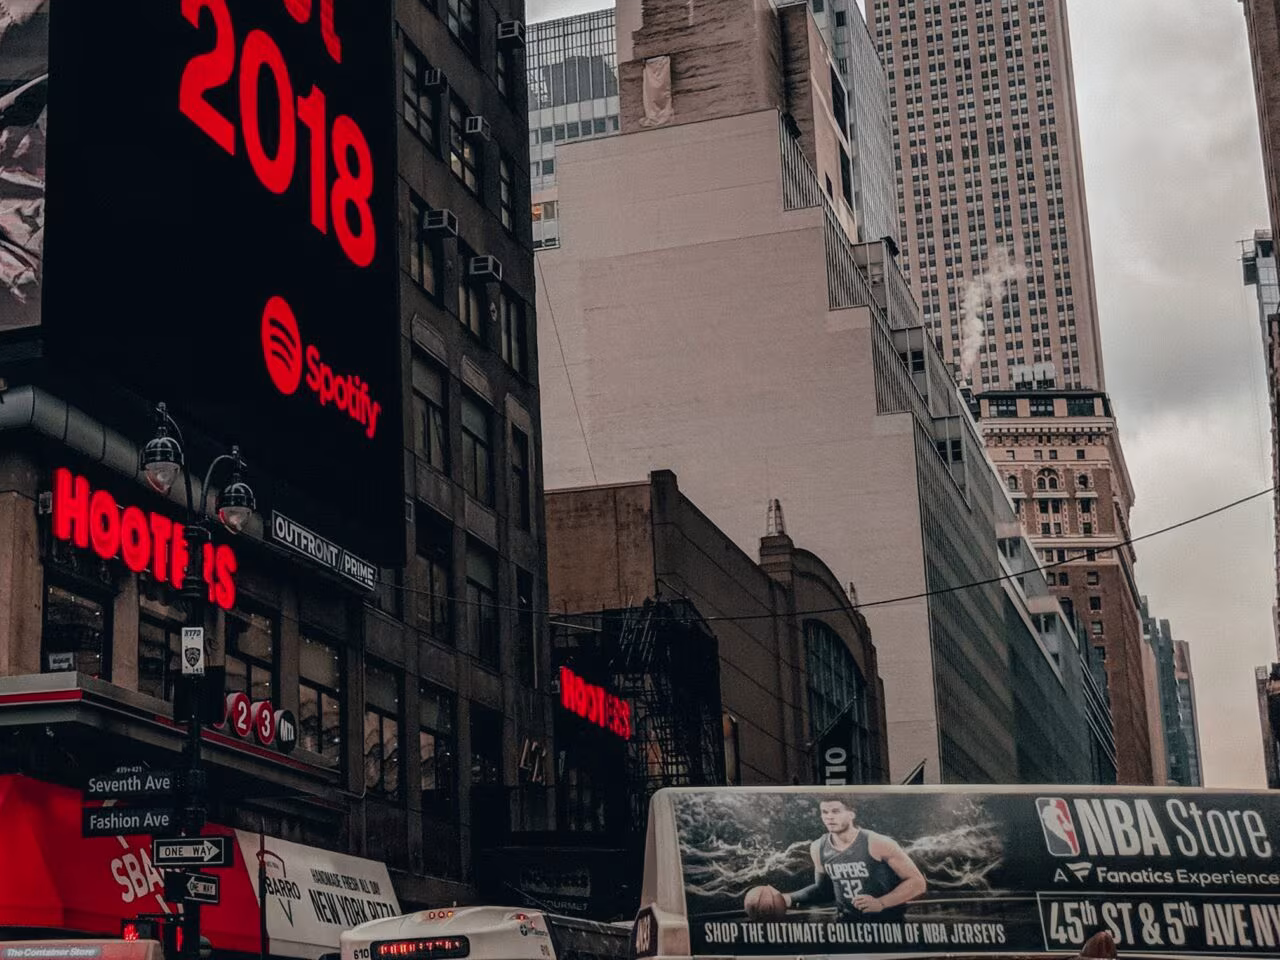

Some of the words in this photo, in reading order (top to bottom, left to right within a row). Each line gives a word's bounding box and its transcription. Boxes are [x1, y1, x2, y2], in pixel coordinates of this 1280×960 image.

[306, 343, 380, 440] Spotify
[275, 516, 338, 567] OUTFRONT
[344, 554, 374, 587] PRIME
[237, 700, 248, 730] 2
[261, 709, 271, 737] 3
[88, 775, 141, 793] Seventh
[144, 774, 171, 790] Ave
[90, 812, 140, 830] Fashion
[143, 812, 170, 827] Ave
[1072, 798, 1172, 856] NBA
[1166, 798, 1273, 858] Store
[164, 846, 184, 857] ONE
[192, 845, 213, 856] WAY
[310, 868, 342, 889] HANDMADE
[341, 874, 360, 892] FRESH
[358, 878, 371, 895] ALL
[369, 880, 382, 896] DAY
[1053, 868, 1069, 882] A
[1096, 866, 1174, 884] Fanatics
[1176, 868, 1280, 887] Experience
[840, 879, 863, 899] 32
[308, 888, 342, 926] NEW
[336, 894, 368, 927] YORK
[704, 922, 739, 944] SHOP
[740, 922, 766, 944] THE
[767, 922, 826, 944] ULTIMATE
[827, 922, 902, 944] COLLECTION
[904, 923, 921, 944] OF
[922, 924, 948, 944] NBA
[950, 924, 1007, 945] JERSEYS
[1049, 900, 1098, 945] 45th
[1101, 902, 1136, 945] ST
[1138, 902, 1166, 945] &
[1162, 900, 1199, 945] 5th
[1202, 903, 1253, 947] AVE
[7, 948, 23, 957] The
[24, 947, 70, 957] Container
[70, 947, 96, 957] Store
[353, 948, 370, 960] 610
